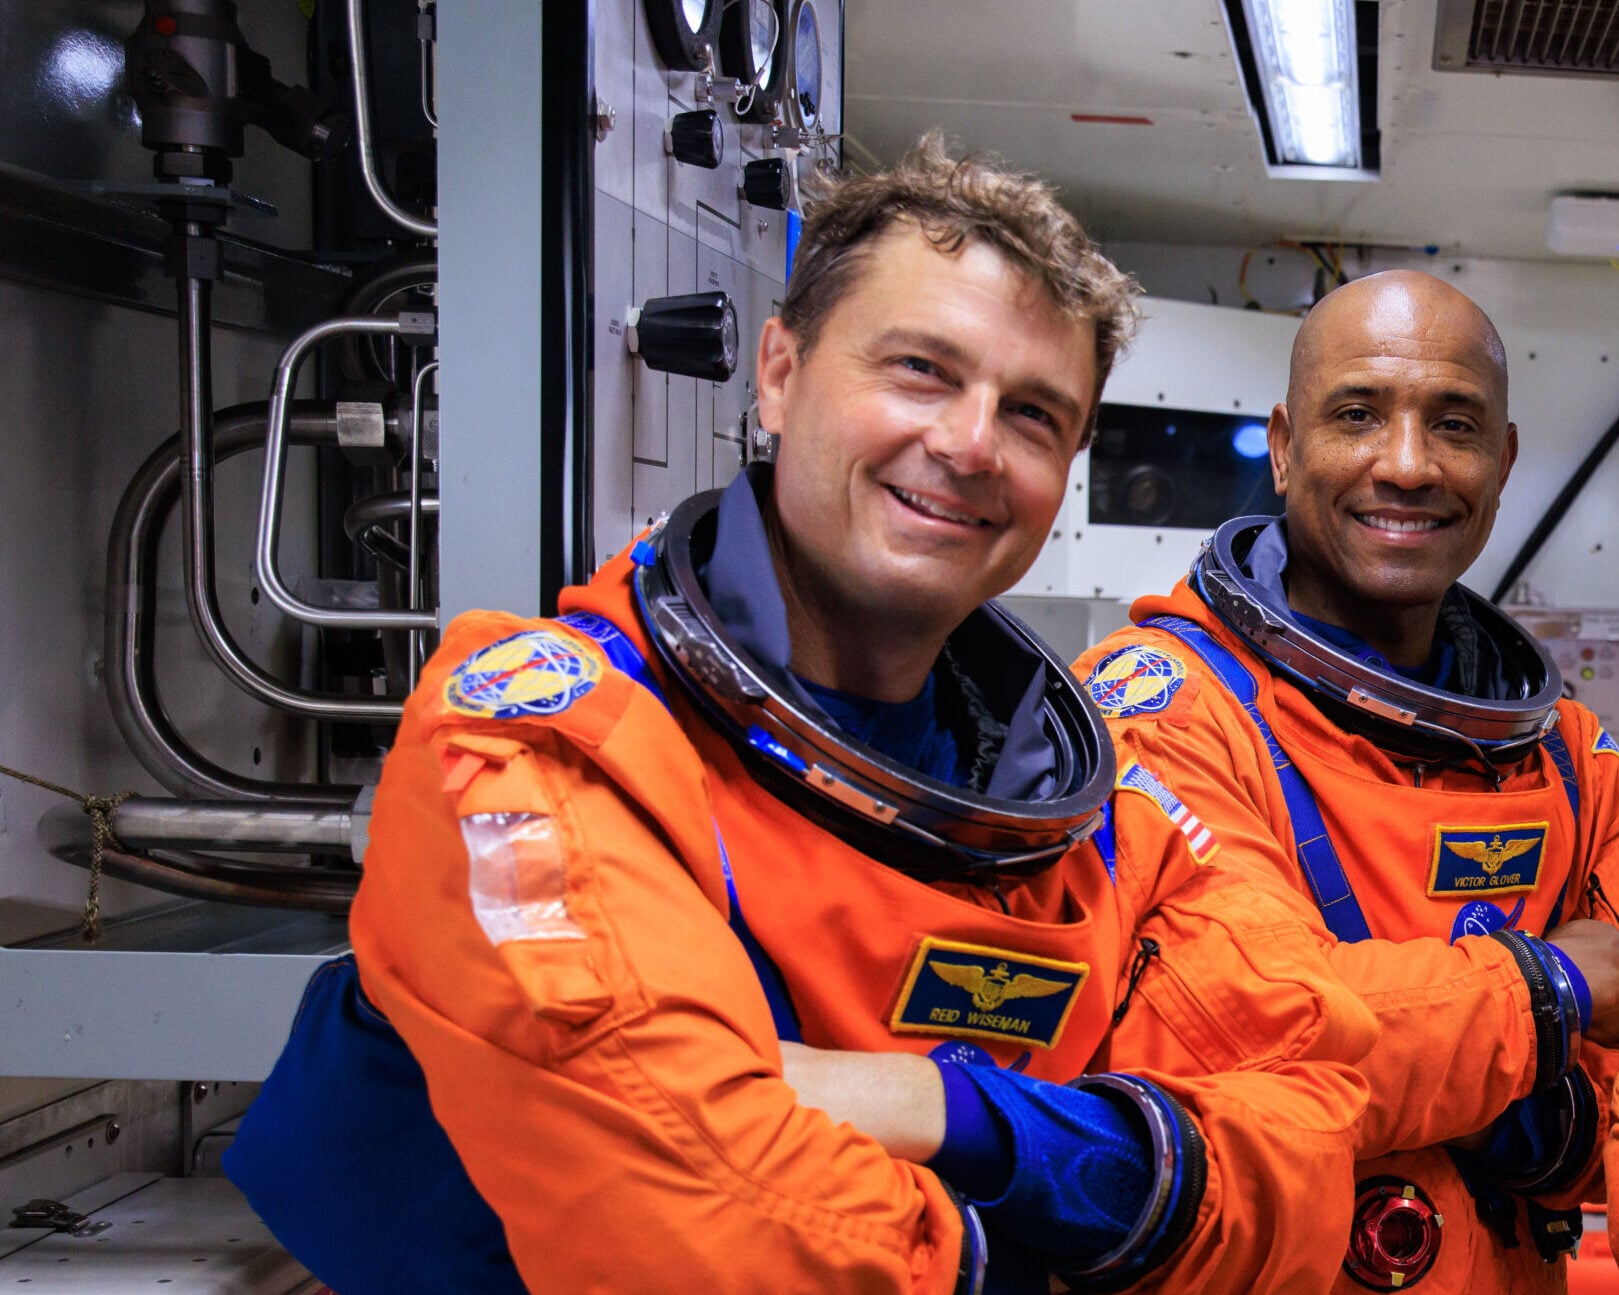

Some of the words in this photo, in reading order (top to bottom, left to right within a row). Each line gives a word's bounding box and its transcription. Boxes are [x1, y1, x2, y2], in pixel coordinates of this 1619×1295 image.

[1454, 876, 1486, 888] VICTOR
[1489, 873, 1521, 886] GLOVER
[929, 1008, 961, 1023] REID
[966, 1012, 1031, 1034] WISEMAN
